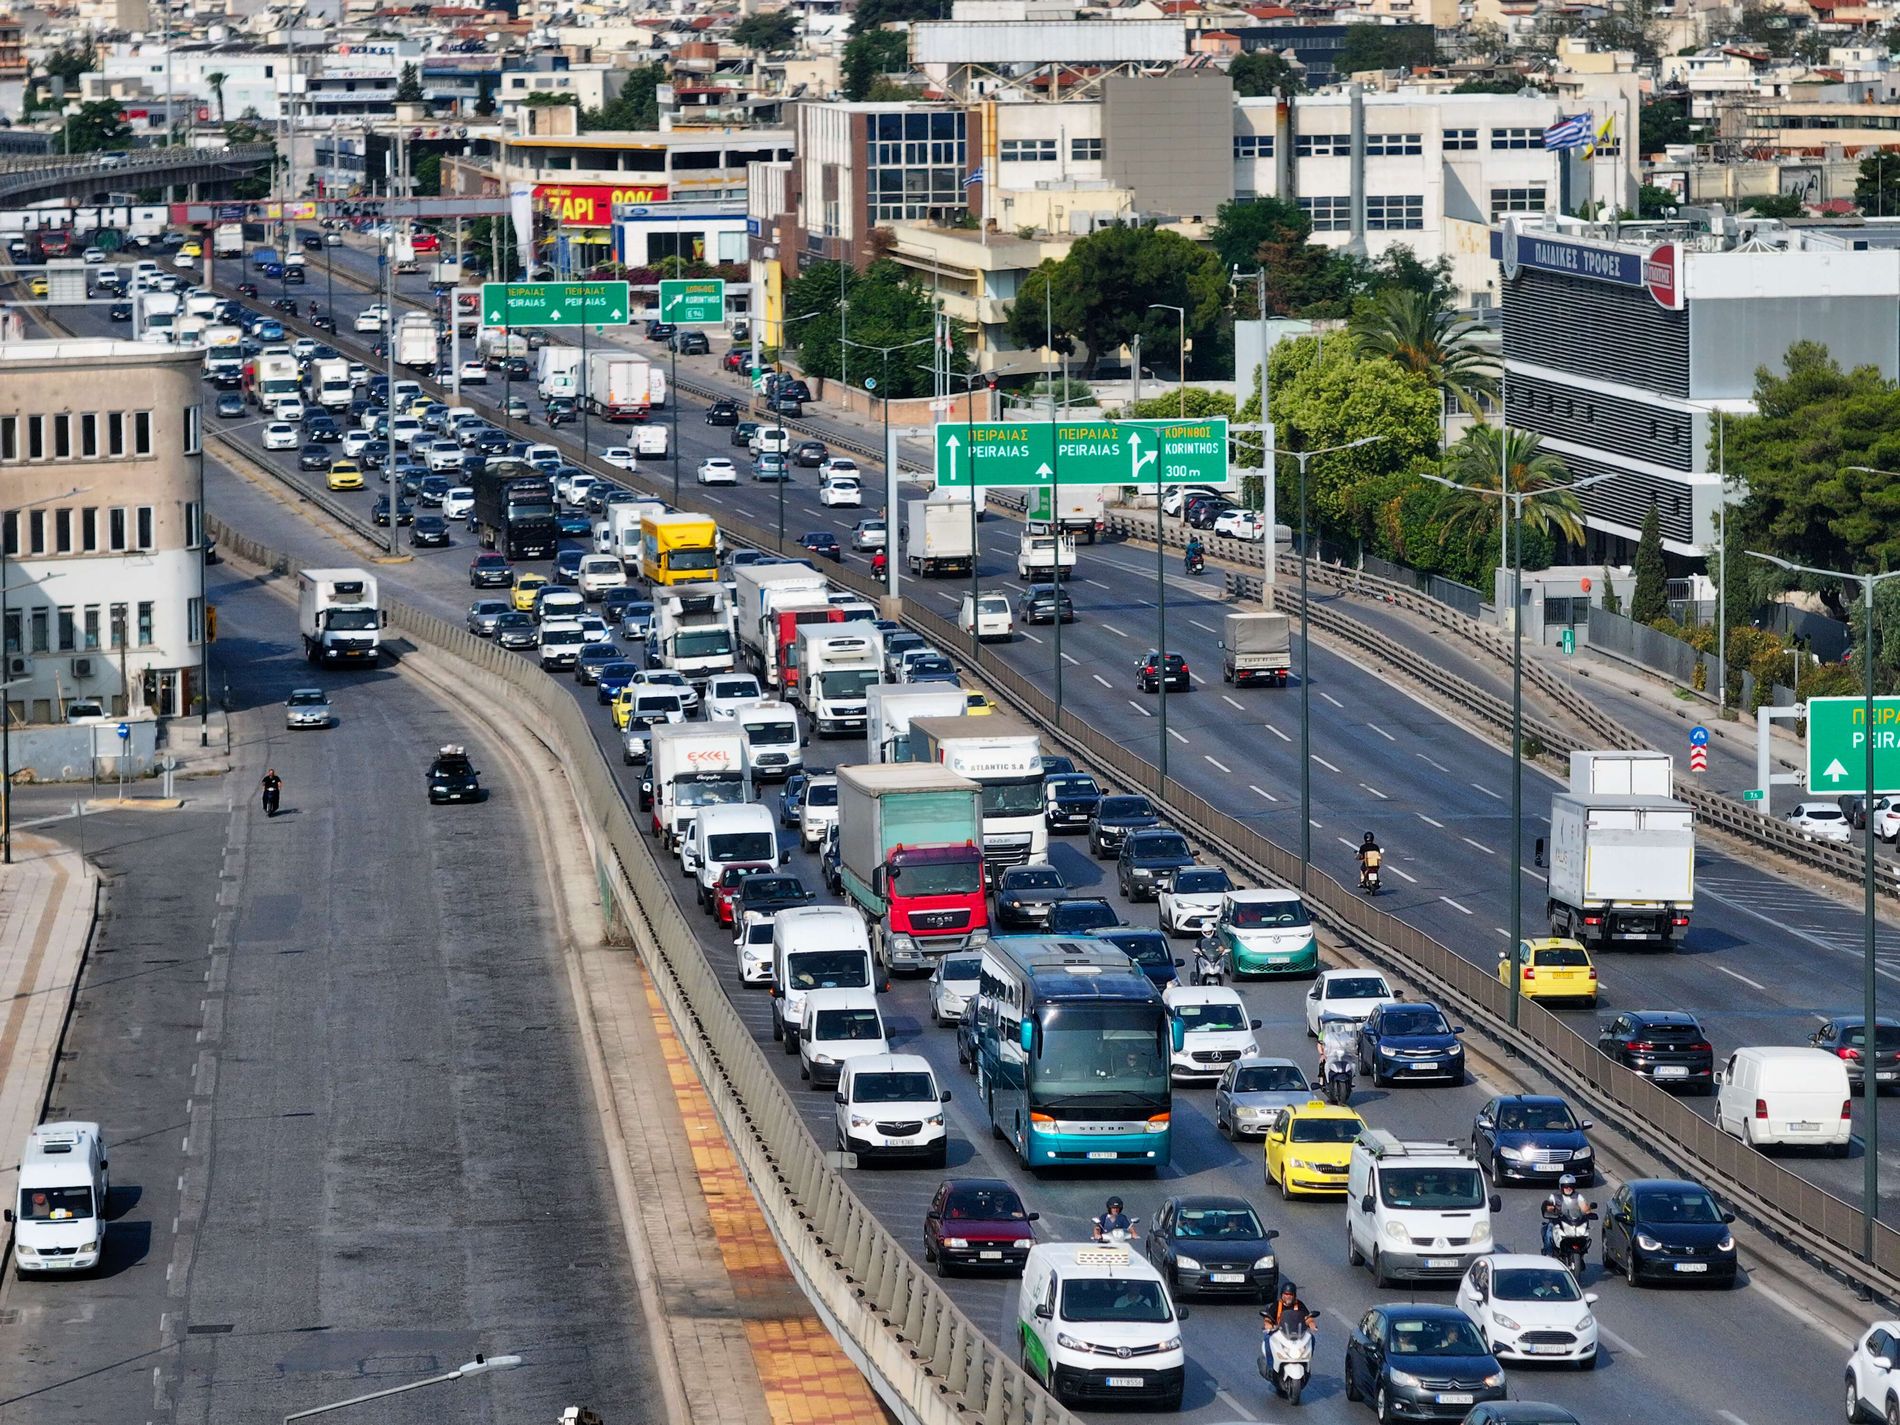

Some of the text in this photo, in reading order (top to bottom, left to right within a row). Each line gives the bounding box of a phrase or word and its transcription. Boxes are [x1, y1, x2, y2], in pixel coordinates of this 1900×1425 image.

[1535, 242, 1621, 277] ΠΑΙΔΙΚΕΣ ΤΡΟΦΕΣ
[967, 428, 1029, 442] ΠΕΙΡΑΙΑΣ
[1058, 428, 1119, 441] ΠΕΙΡΑΙΑΣ
[1165, 426, 1211, 439] ΚΟΡΙΝΘΟΣ
[967, 445, 1030, 458] PEIRAIAS
[1058, 444, 1120, 457] PEIRAIAS
[1165, 442, 1219, 455] KORINTHOS
[1165, 465, 1200, 477] 300 m
[970, 763, 1009, 772] ATLANTIC
